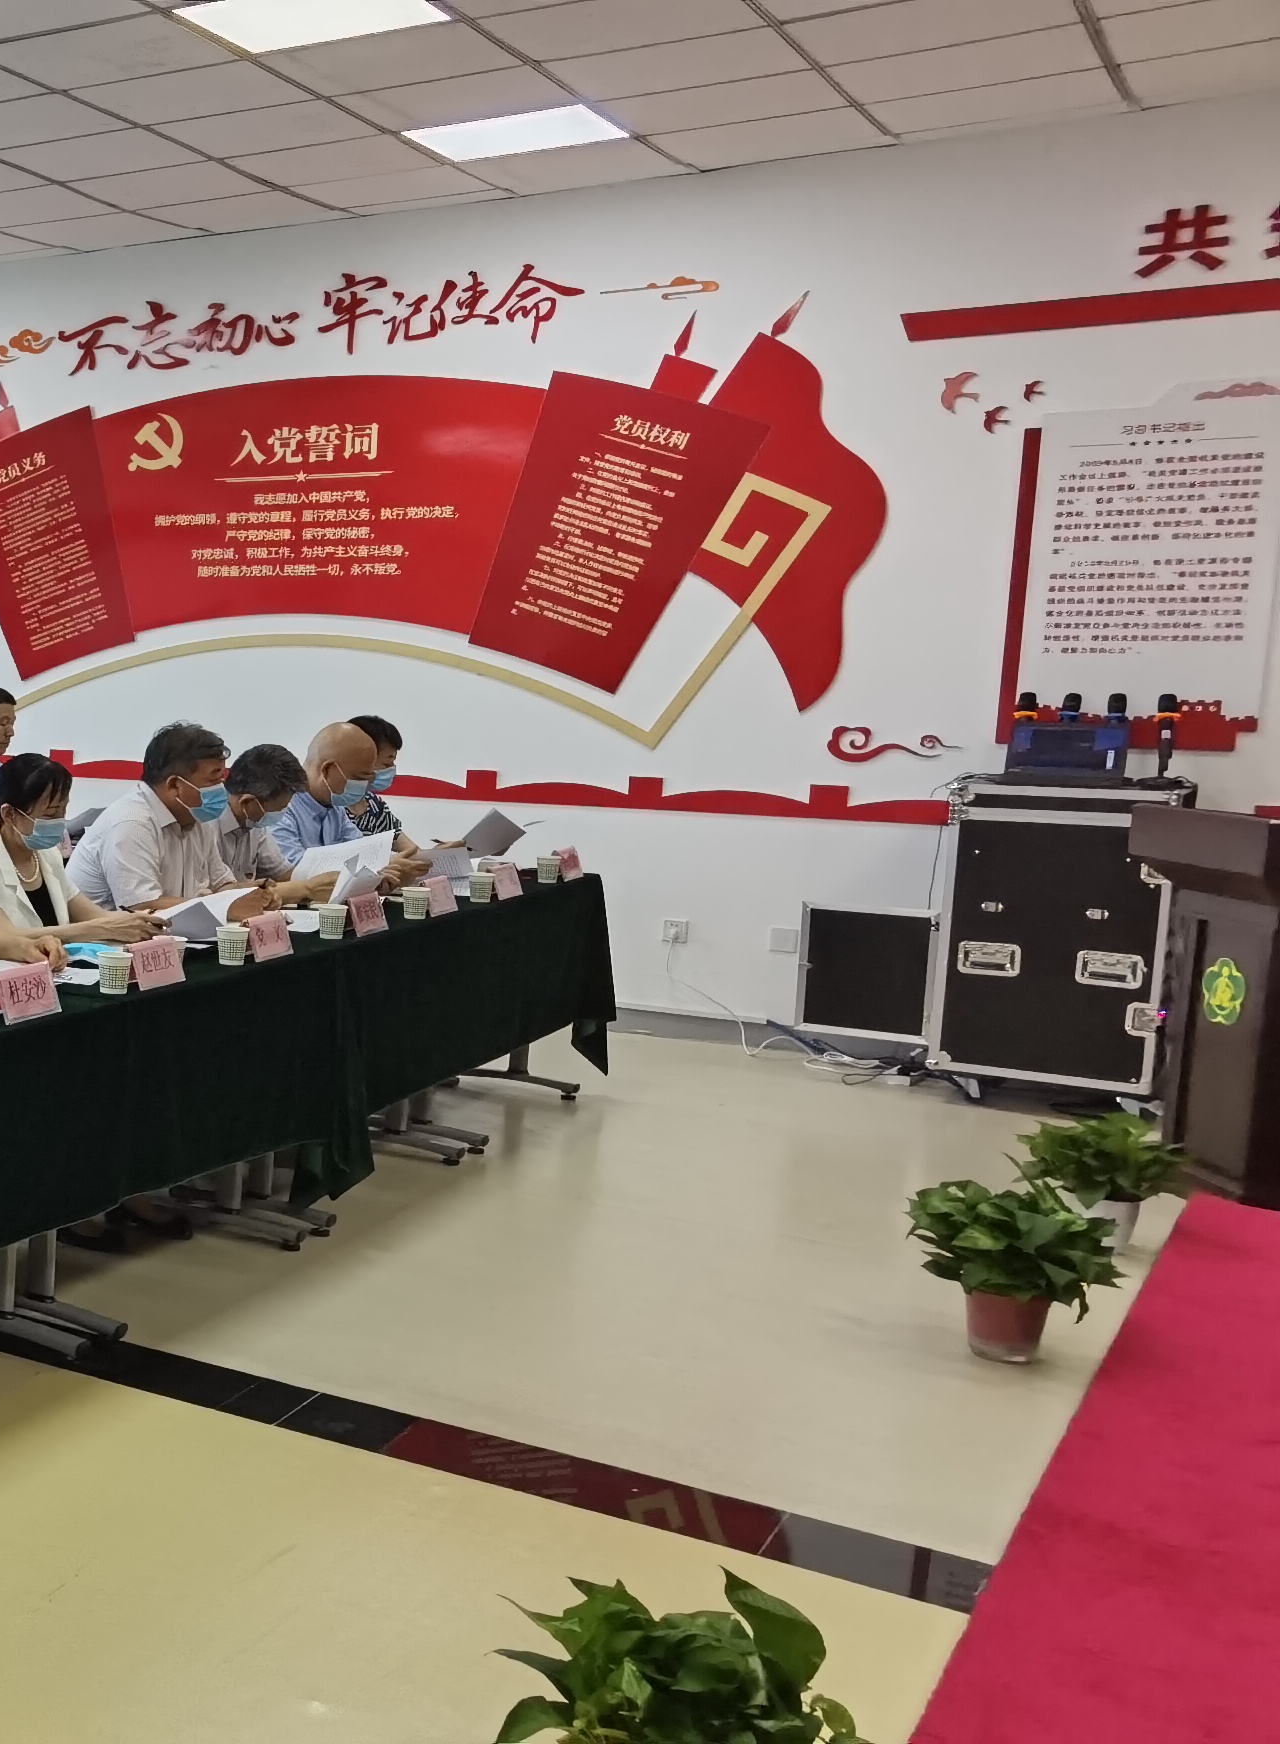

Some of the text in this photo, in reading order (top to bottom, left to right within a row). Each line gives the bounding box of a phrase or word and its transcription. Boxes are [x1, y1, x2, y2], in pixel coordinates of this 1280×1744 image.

[1135, 203, 1280, 278] 共
[57, 264, 585, 376] 不忘初心 牢记使命
[229, 422, 380, 467] 入党誓词
[610, 414, 691, 450] 党员权利
[7, 974, 47, 1006] 杜安沙
